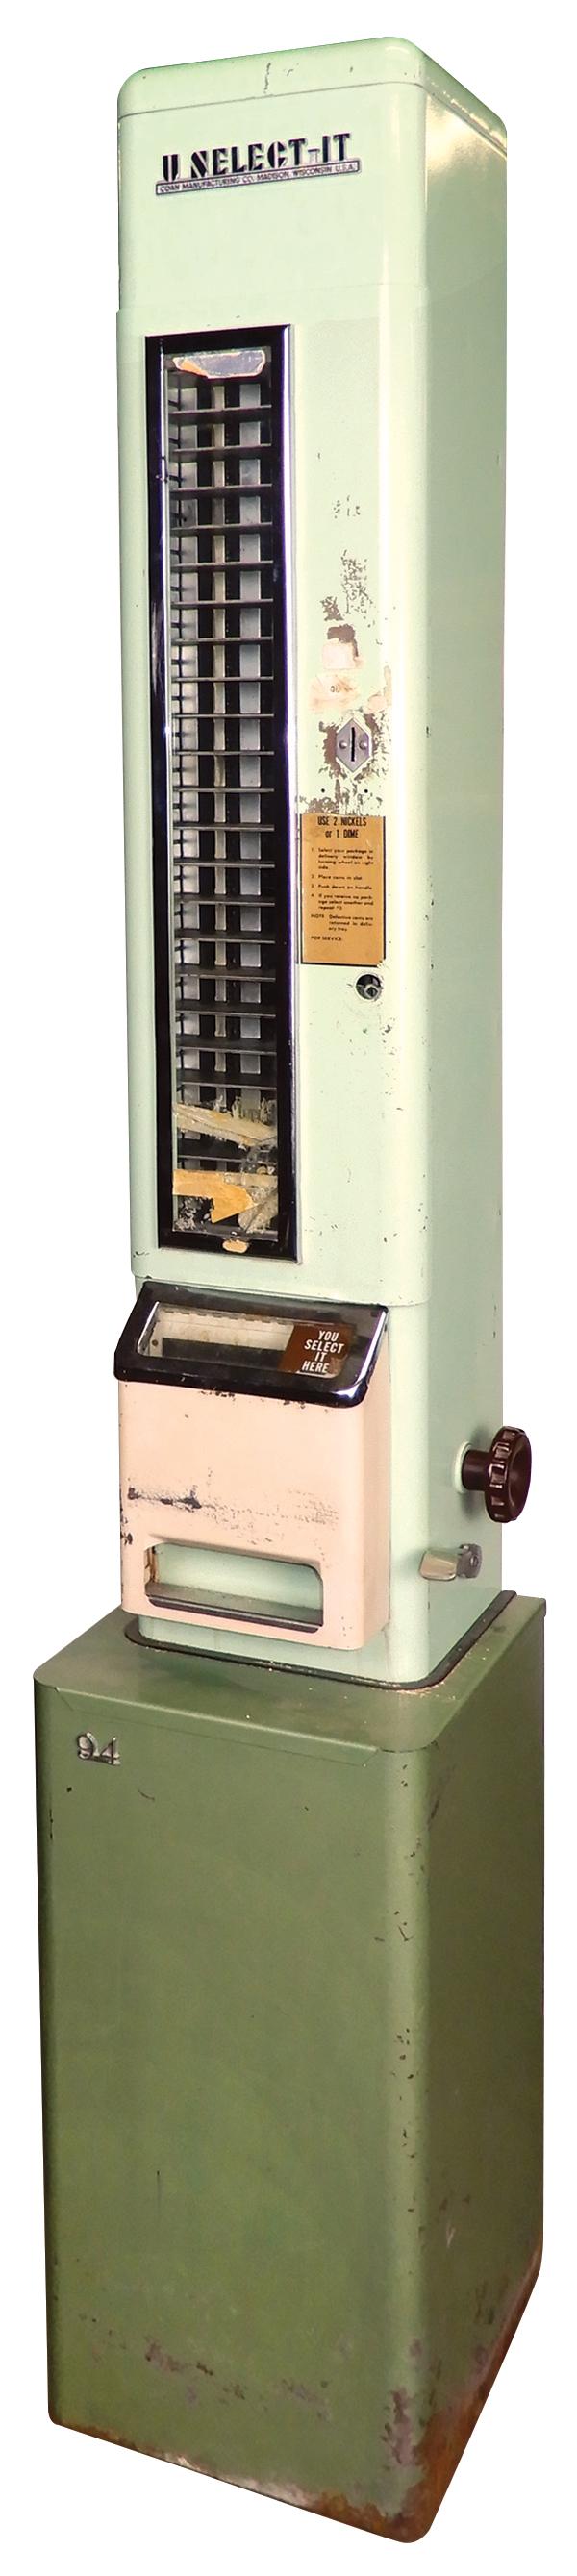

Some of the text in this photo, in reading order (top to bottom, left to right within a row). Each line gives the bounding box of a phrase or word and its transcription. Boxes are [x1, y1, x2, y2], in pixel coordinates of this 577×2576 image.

[163, 133, 351, 182] U SELECT-IT
[182, 177, 240, 189] MANUFACTURING
[292, 166, 332, 176] WISCONSIN
[317, 816, 366, 826] USE 2 NICKELS
[337, 829, 339, 838] 1
[343, 829, 359, 838] DIME
[318, 1331, 339, 1341] YOU
[304, 1339, 344, 1354] SELECT
[314, 1352, 327, 1362] IT
[302, 1361, 330, 1373] HERE
[77, 1732, 121, 1765] 94
